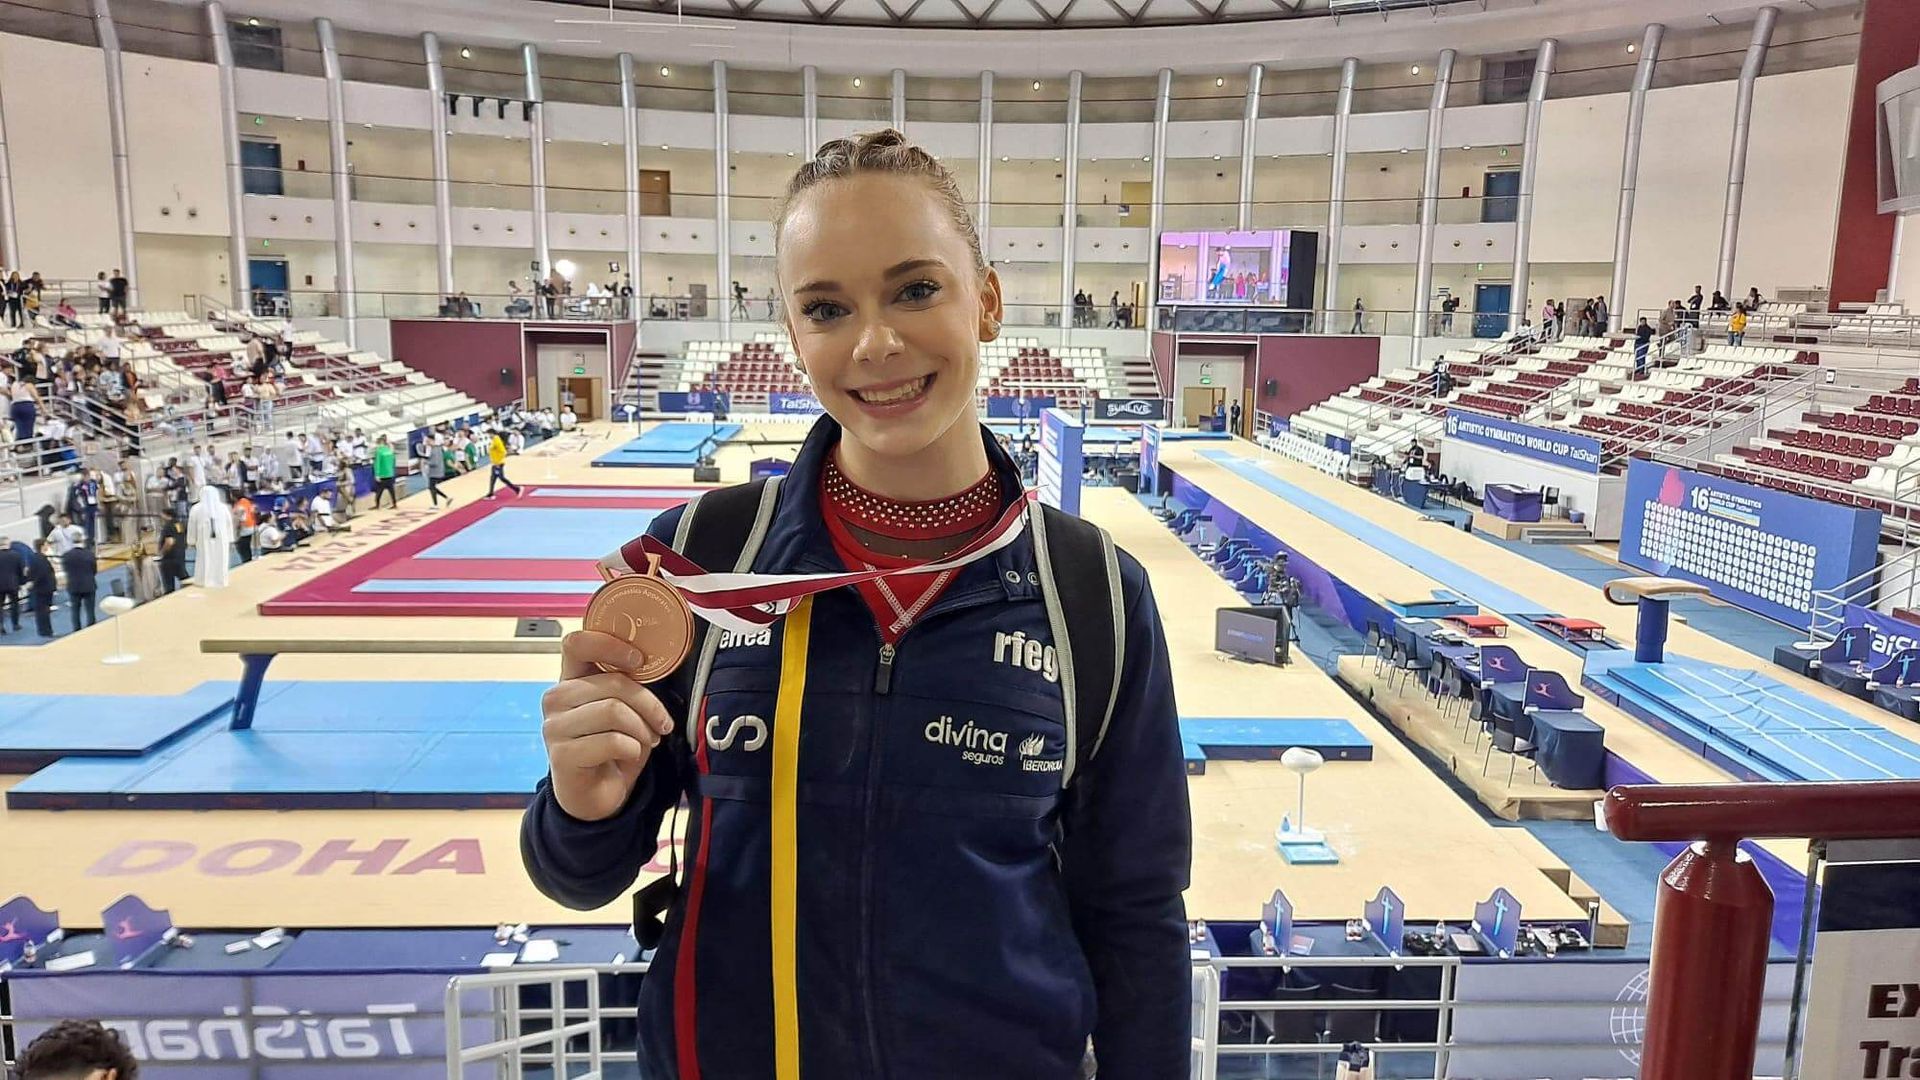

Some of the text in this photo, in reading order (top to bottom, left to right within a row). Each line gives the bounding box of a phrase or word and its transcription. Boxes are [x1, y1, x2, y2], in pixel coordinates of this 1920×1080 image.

[779, 398, 823, 410] TaiSha
[1107, 402, 1151, 415] SUNLIVE
[1458, 421, 1484, 436] ARTISTIC
[1485, 427, 1526, 445] GYMNASTICS
[1527, 437, 1552, 452] WORLD
[1553, 443, 1569, 456] CUP
[1569, 446, 1598, 463] TaiShan
[993, 631, 1059, 682] rfeg
[925, 716, 1008, 753] divina
[962, 750, 1004, 765] seguros
[85, 838, 486, 877] DOHA
